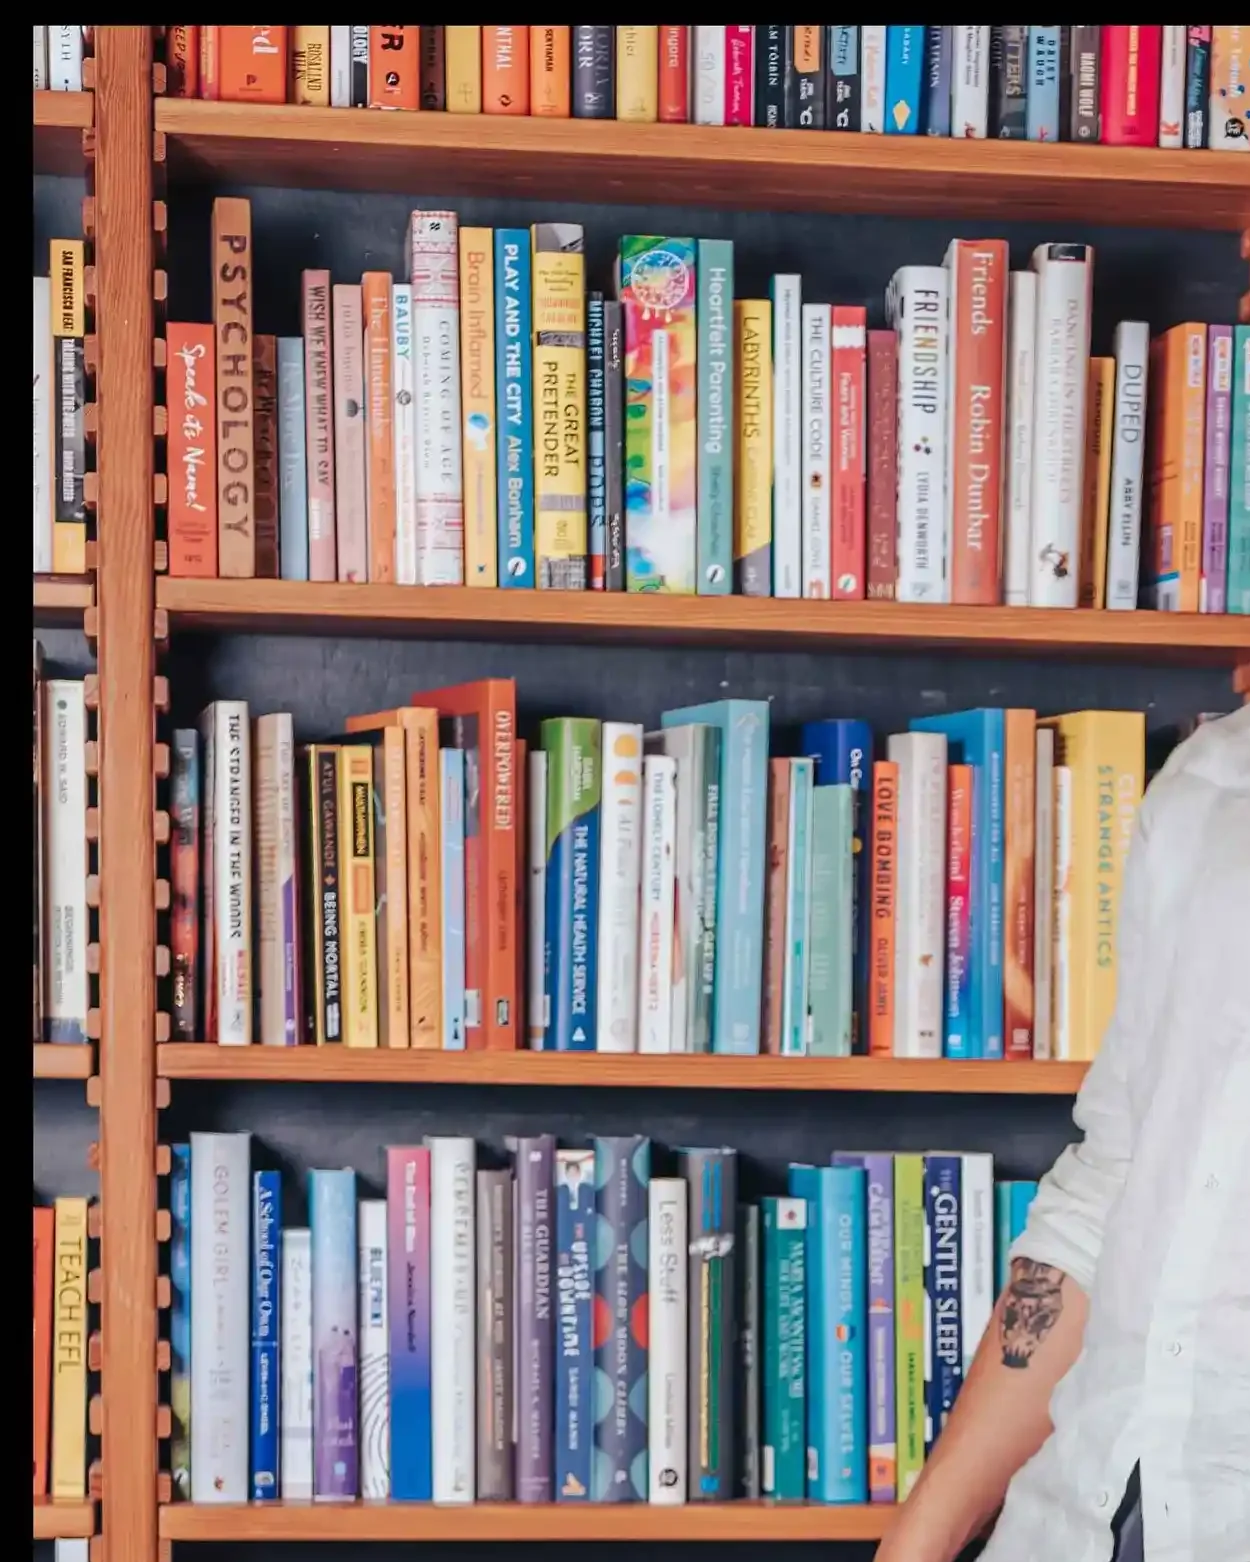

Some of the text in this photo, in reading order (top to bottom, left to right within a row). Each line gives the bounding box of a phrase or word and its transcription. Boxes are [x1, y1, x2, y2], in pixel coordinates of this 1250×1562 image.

[308, 43, 322, 91] ROSALIND
[1046, 40, 1055, 84] DAISY
[1079, 52, 1095, 117] NAOMI WOLF
[62, 251, 74, 310] SAN FRANCISCO
[308, 286, 326, 321] WISH
[395, 293, 409, 360] BAUBY
[467, 251, 489, 399] Brain Inflamed
[220, 234, 249, 538] PSYCHOLOGY
[312, 394, 328, 432] WHAT
[504, 244, 524, 548] PLAY AND THE CITY Alex Bonham
[543, 360, 561, 477] PRETENDER
[705, 267, 727, 453] Heartfelt Parenting
[743, 316, 761, 438] LABYRINTHS
[809, 316, 823, 414] THE CULTURE
[966, 251, 994, 551] Friends Robin Dunbar
[1120, 364, 1143, 444] DUPED
[175, 341, 206, 512] Speak Name!
[563, 403, 580, 467] GREAT
[912, 289, 939, 570] FRIENDSHIP LYDIA DENWORTH
[493, 710, 512, 831] OVERPOWERED!
[228, 746, 241, 939] STRANGER WOODS
[322, 760, 338, 1000] ATUL GAWANDE BEING MORTAL
[651, 845, 662, 902] CENTURY
[876, 777, 893, 919] LOVE BOMBING
[948, 788, 965, 1018] Wonderland Steven Johnson
[1097, 765, 1112, 969] STRANGE ANTICS
[572, 825, 588, 1014] THE NATURAL HEALTH SERVICE
[213, 1165, 229, 1286] GOLEM GIRL
[260, 1187, 273, 1200] A
[534, 1188, 550, 1320] THE GUARDIAN
[659, 1201, 678, 1307] Less Stuff
[839, 1214, 852, 1250] OUR
[58, 1236, 82, 1374] TEACH EFL
[370, 1247, 384, 1328] BLUEPRINT
[573, 1241, 591, 1300] UPSIDE
[616, 1243, 628, 1374] THE MOON
[839, 1258, 852, 1311] MINDS
[935, 1193, 958, 1365] GENTLE SLEEP
[839, 1350, 852, 1388] OUR
